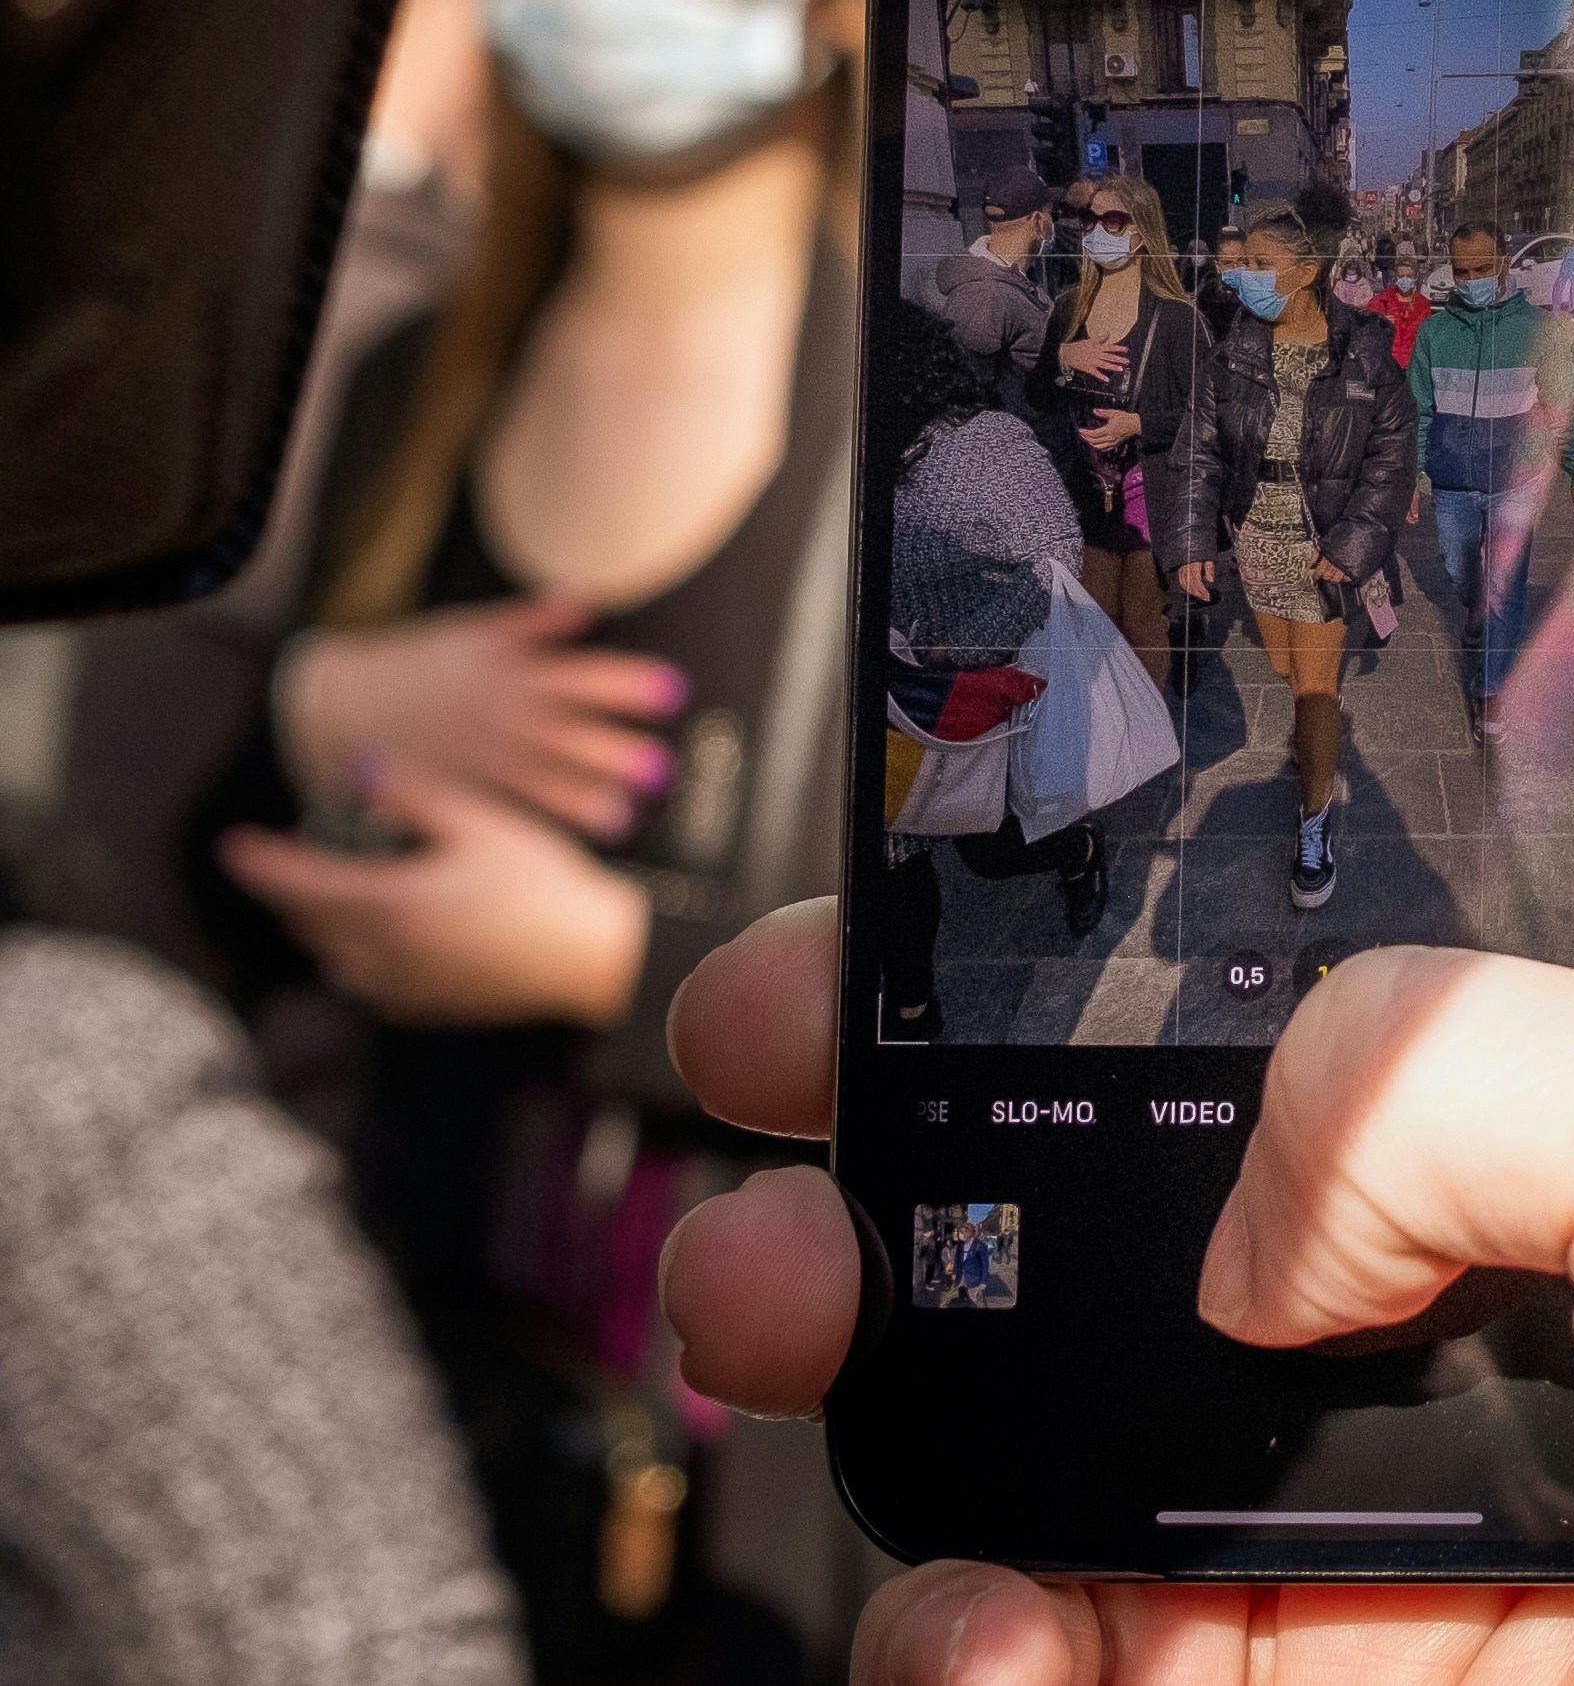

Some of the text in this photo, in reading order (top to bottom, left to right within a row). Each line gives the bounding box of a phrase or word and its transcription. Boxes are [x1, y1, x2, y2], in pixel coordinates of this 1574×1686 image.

[1230, 966, 1265, 989] 0,5
[992, 1100, 1095, 1124] SLO-MO
[1150, 1100, 1236, 1125] VIDEO
